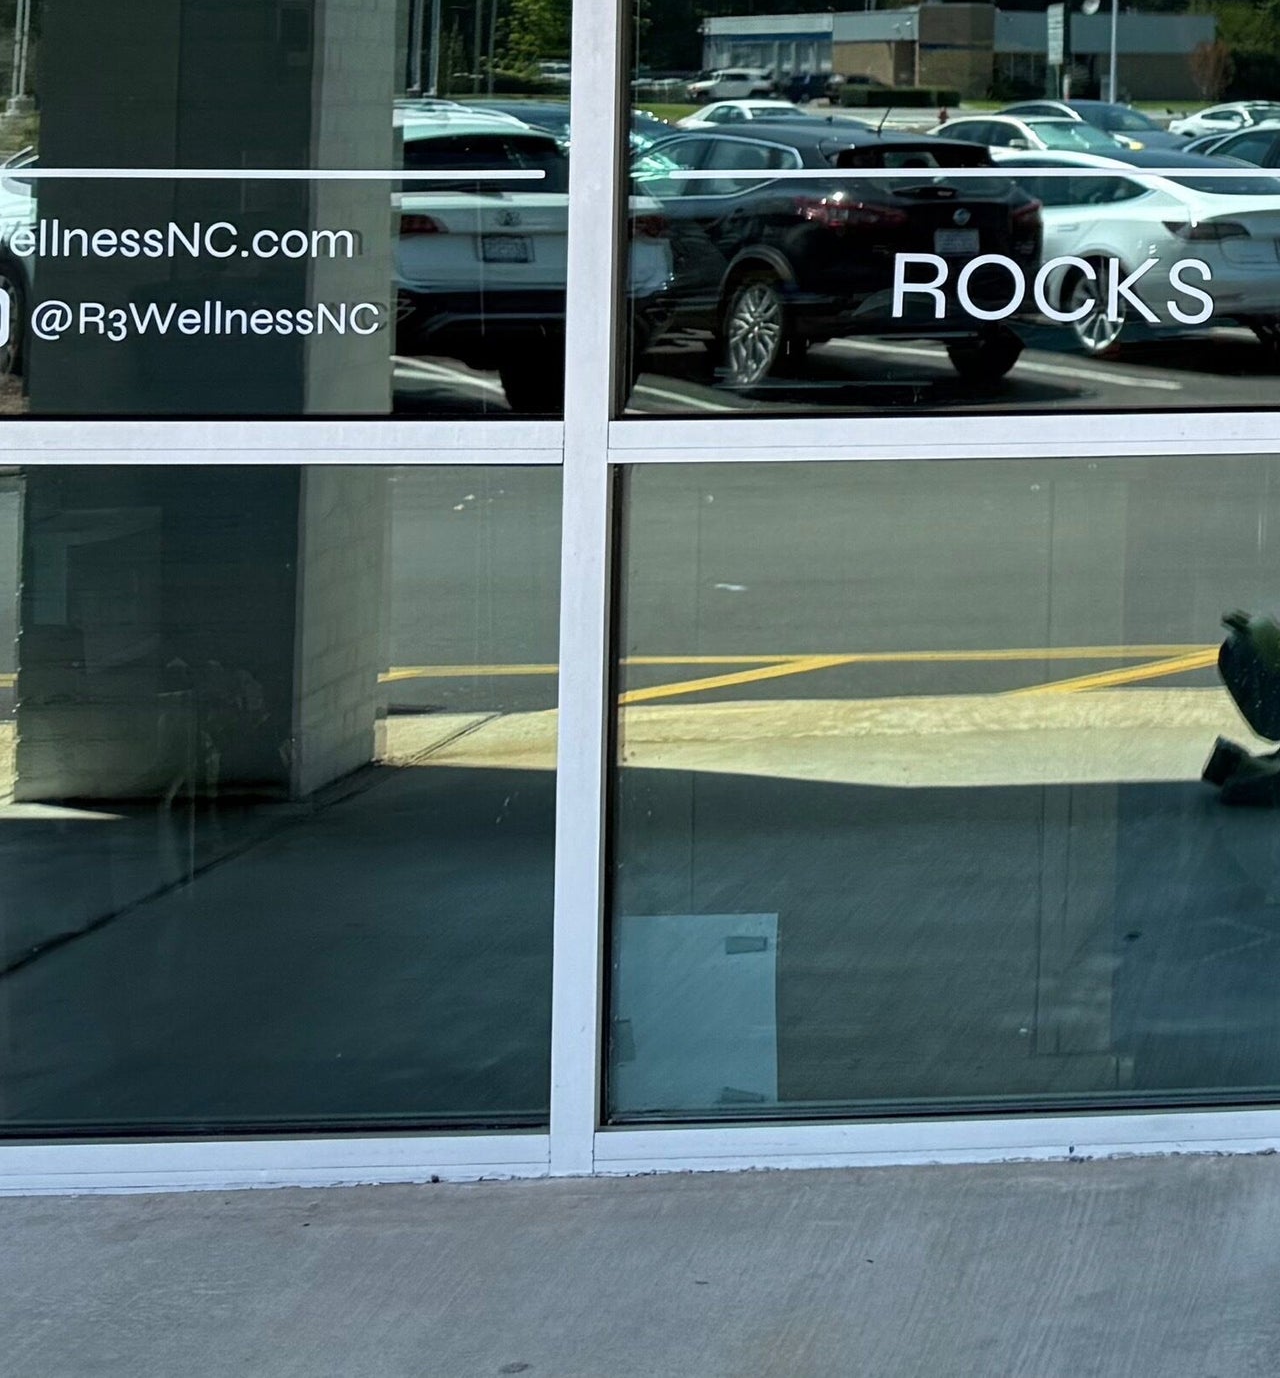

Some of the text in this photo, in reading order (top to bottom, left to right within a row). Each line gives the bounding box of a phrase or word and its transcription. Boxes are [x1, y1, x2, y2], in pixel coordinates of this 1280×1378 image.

[0, 217, 354, 258] ellnessNC.com
[892, 252, 1214, 325] ROCKS
[31, 300, 379, 342] @R3WellnessNC
